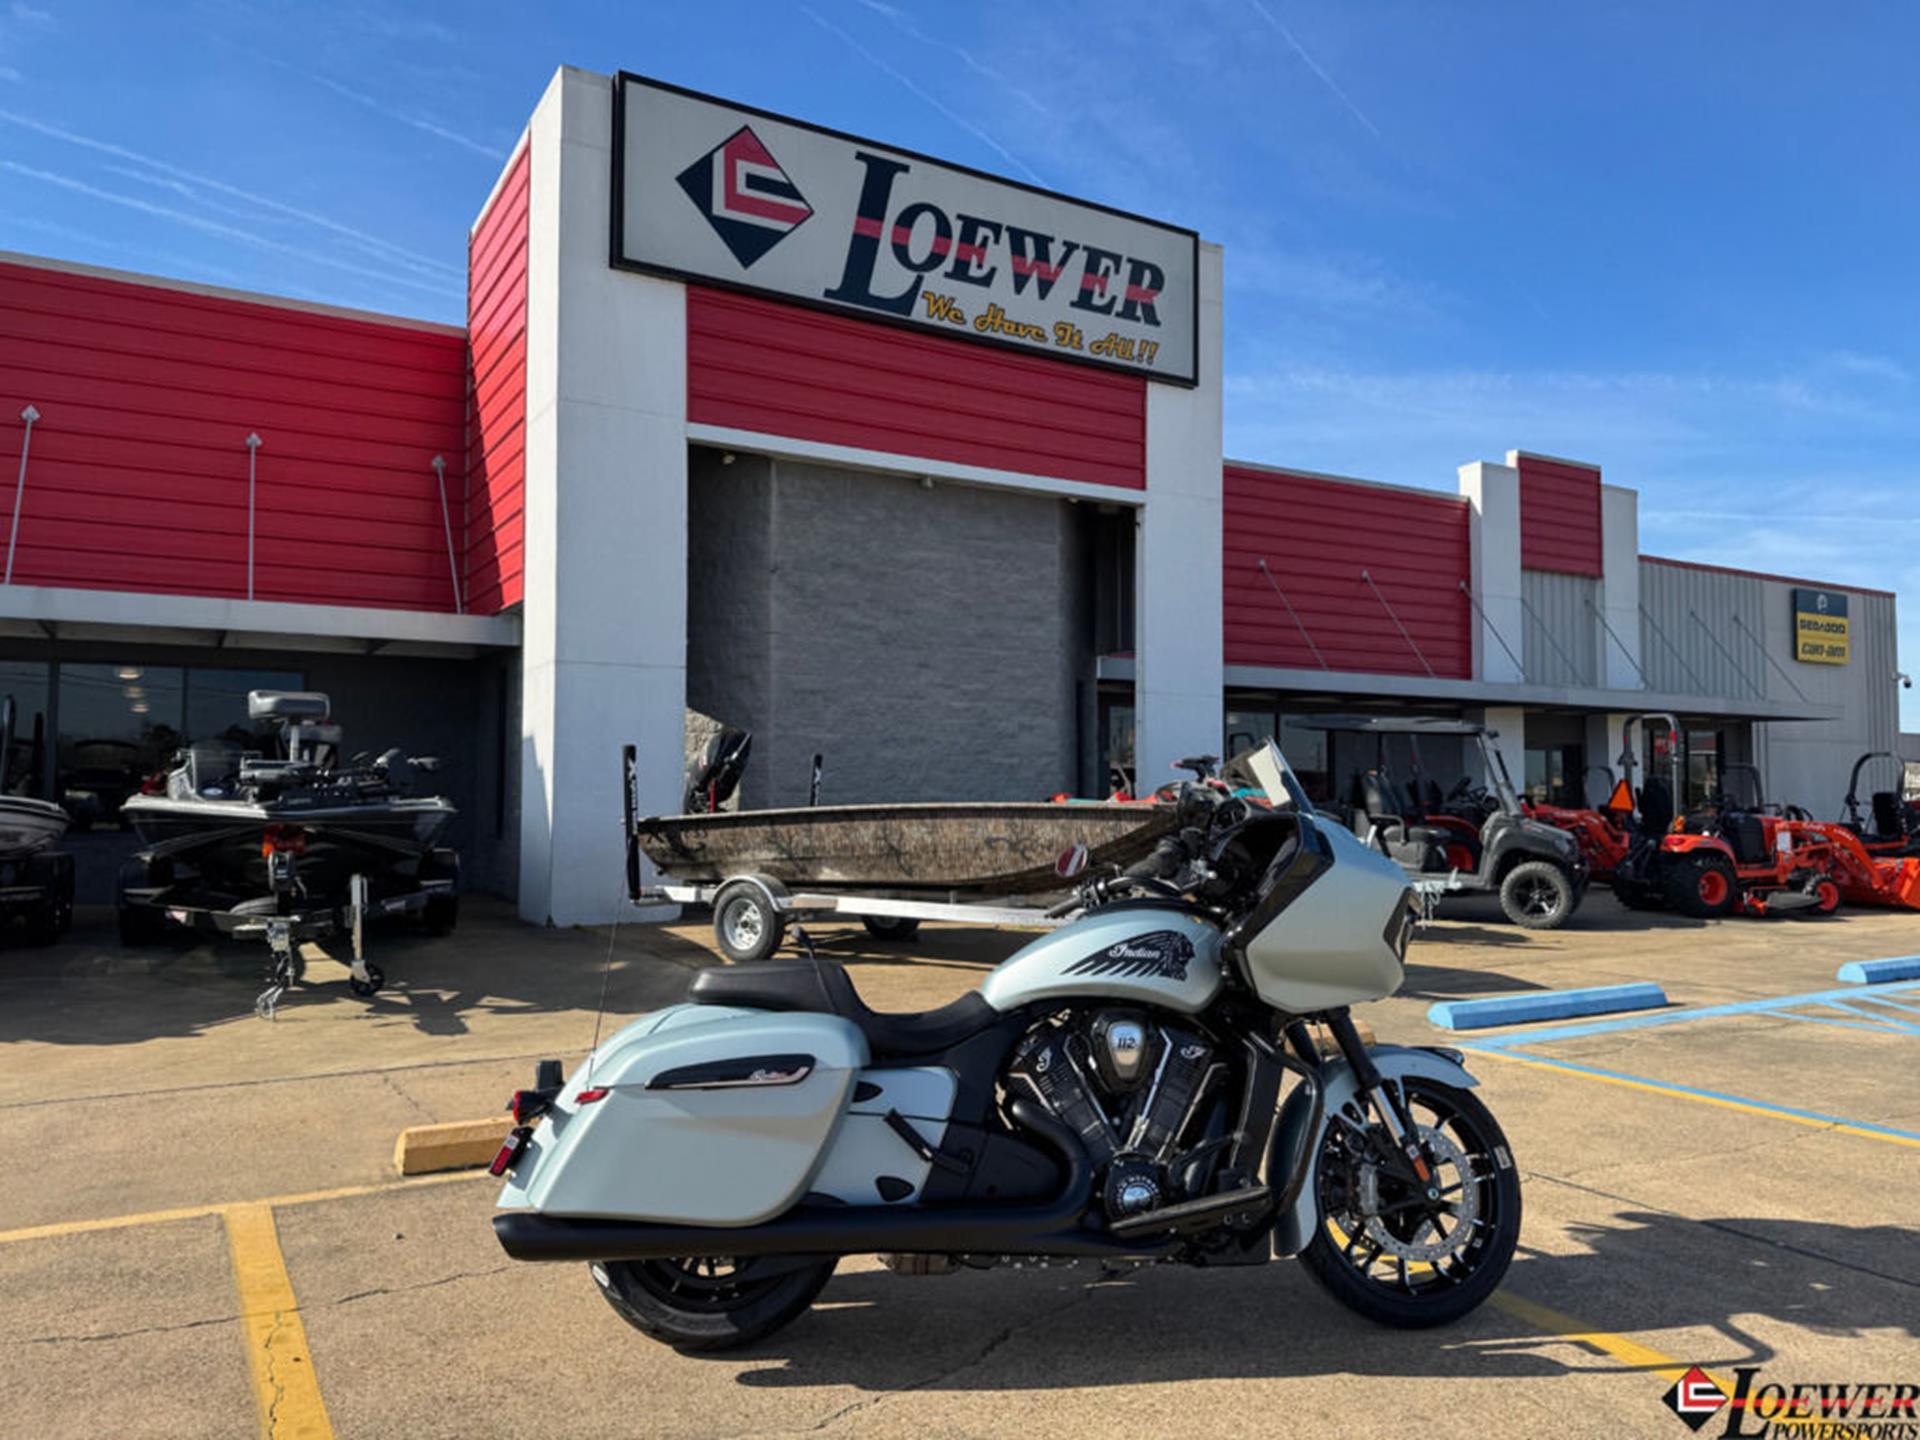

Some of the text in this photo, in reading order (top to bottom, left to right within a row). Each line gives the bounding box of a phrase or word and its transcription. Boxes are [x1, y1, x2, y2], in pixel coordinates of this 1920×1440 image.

[823, 151, 1166, 327] LOEWER
[922, 290, 967, 325] We
[973, 302, 1048, 343] Have
[1053, 321, 1084, 350] It
[1108, 943, 1161, 959] Indian
[1117, 1035, 1136, 1049] 112
